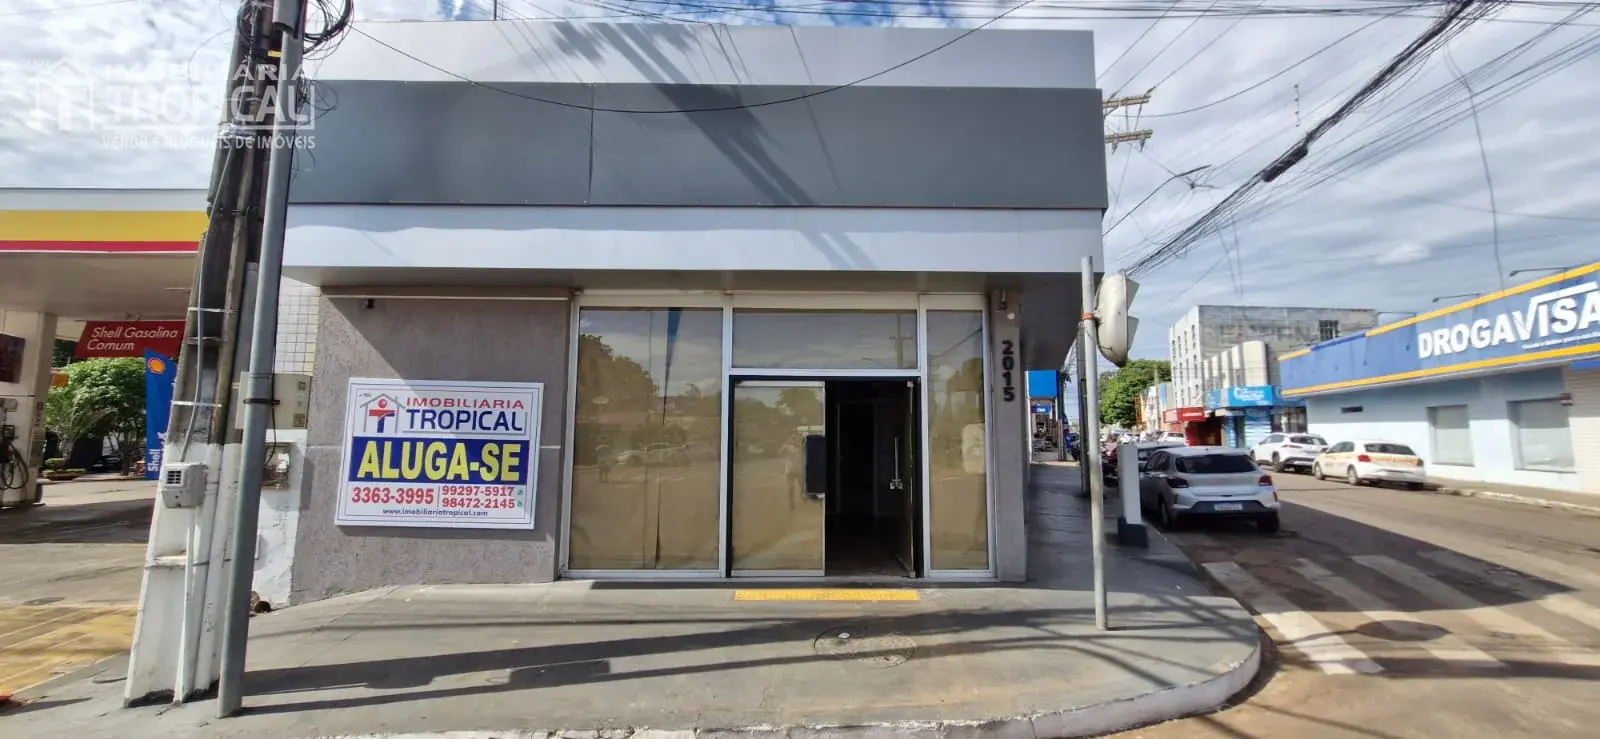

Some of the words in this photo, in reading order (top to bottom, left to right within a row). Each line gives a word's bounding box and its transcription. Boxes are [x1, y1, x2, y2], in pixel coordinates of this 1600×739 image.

[92, 326, 123, 339] Shell
[125, 327, 179, 339] Gasolina
[87, 339, 135, 351] Comum
[1001, 339, 1015, 402] 2015
[406, 409, 523, 432] TROPICAL
[147, 449, 161, 472] Shell
[356, 440, 522, 482] ALUGA-SE
[351, 486, 435, 505] 3363-3995
[441, 485, 514, 498] 99297-5917
[441, 498, 516, 509] 98472-2145
